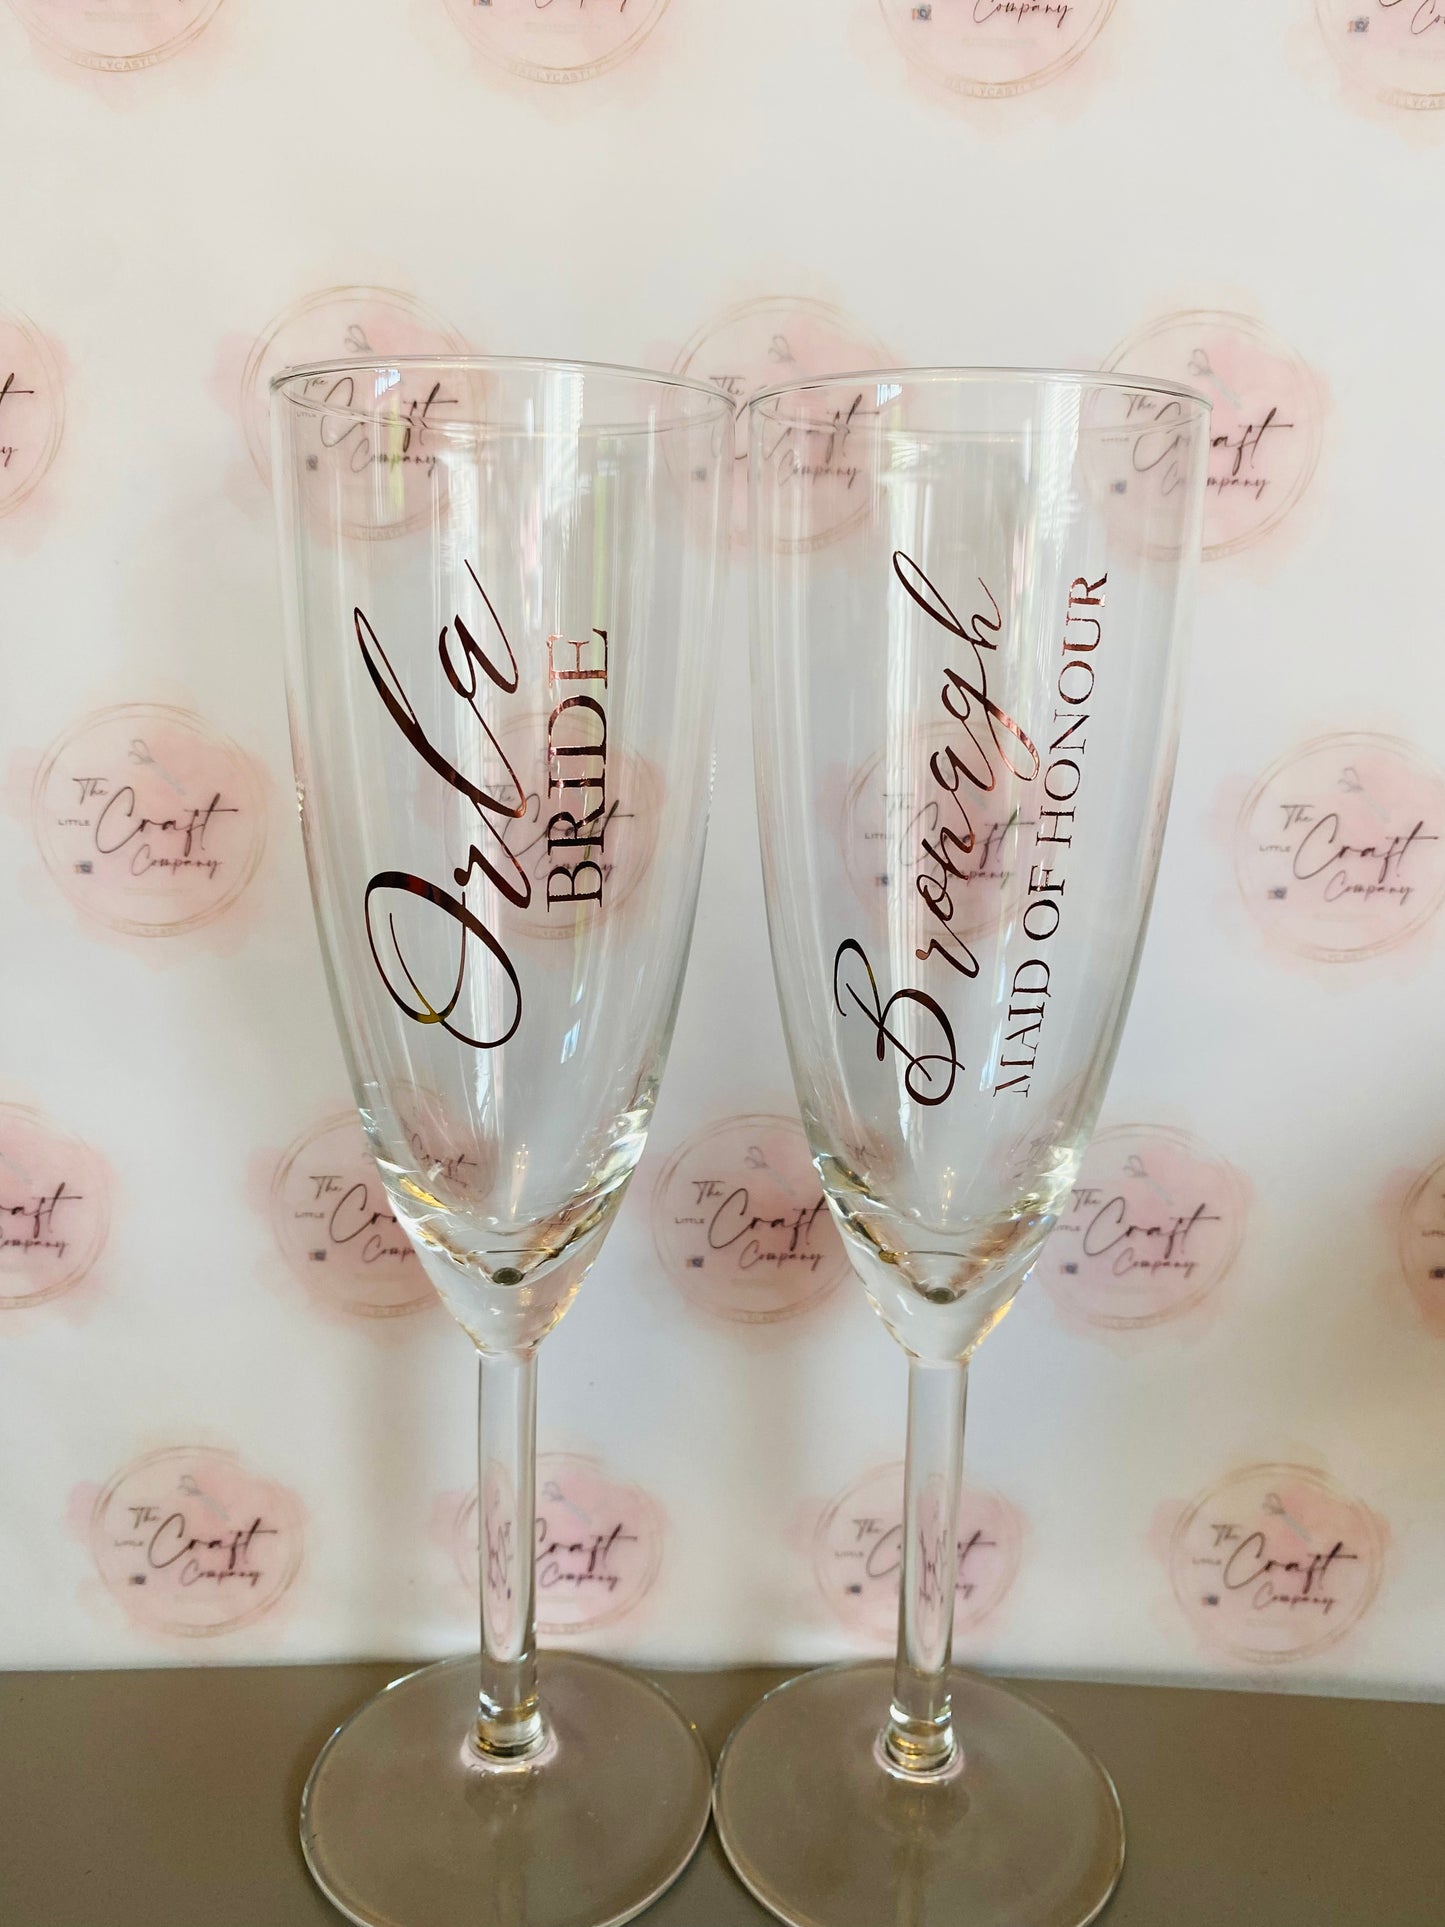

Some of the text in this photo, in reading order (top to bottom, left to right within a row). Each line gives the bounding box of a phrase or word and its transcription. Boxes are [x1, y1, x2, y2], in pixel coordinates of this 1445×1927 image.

[973, 0, 1073, 28] Company
[1122, 393, 1156, 419] The
[1035, 573, 1108, 848] HONOUR
[547, 628, 608, 912] BRIDE
[72, 777, 109, 805] The
[354, 558, 531, 1049] Orla
[96, 786, 239, 857] Craft
[834, 550, 1040, 1106] Bronagh
[1280, 804, 1315, 830] The
[131, 843, 222, 879] Company
[1293, 813, 1439, 883] Craft
[1023, 865, 1066, 941] OF
[1324, 870, 1415, 906] Company
[993, 959, 1052, 1098] MAID
[309, 1175, 343, 1199] The
[692, 1180, 725, 1205] The
[1071, 1188, 1103, 1212] The
[708, 1188, 830, 1251] Craft
[1083, 1196, 1221, 1259] Craft
[739, 1239, 824, 1271] Company
[1112, 1247, 1199, 1278] Company
[129, 1506, 161, 1529] The
[148, 1512, 278, 1570] Craft
[179, 1558, 264, 1587] Company
[1223, 1531, 1358, 1595] Craft
